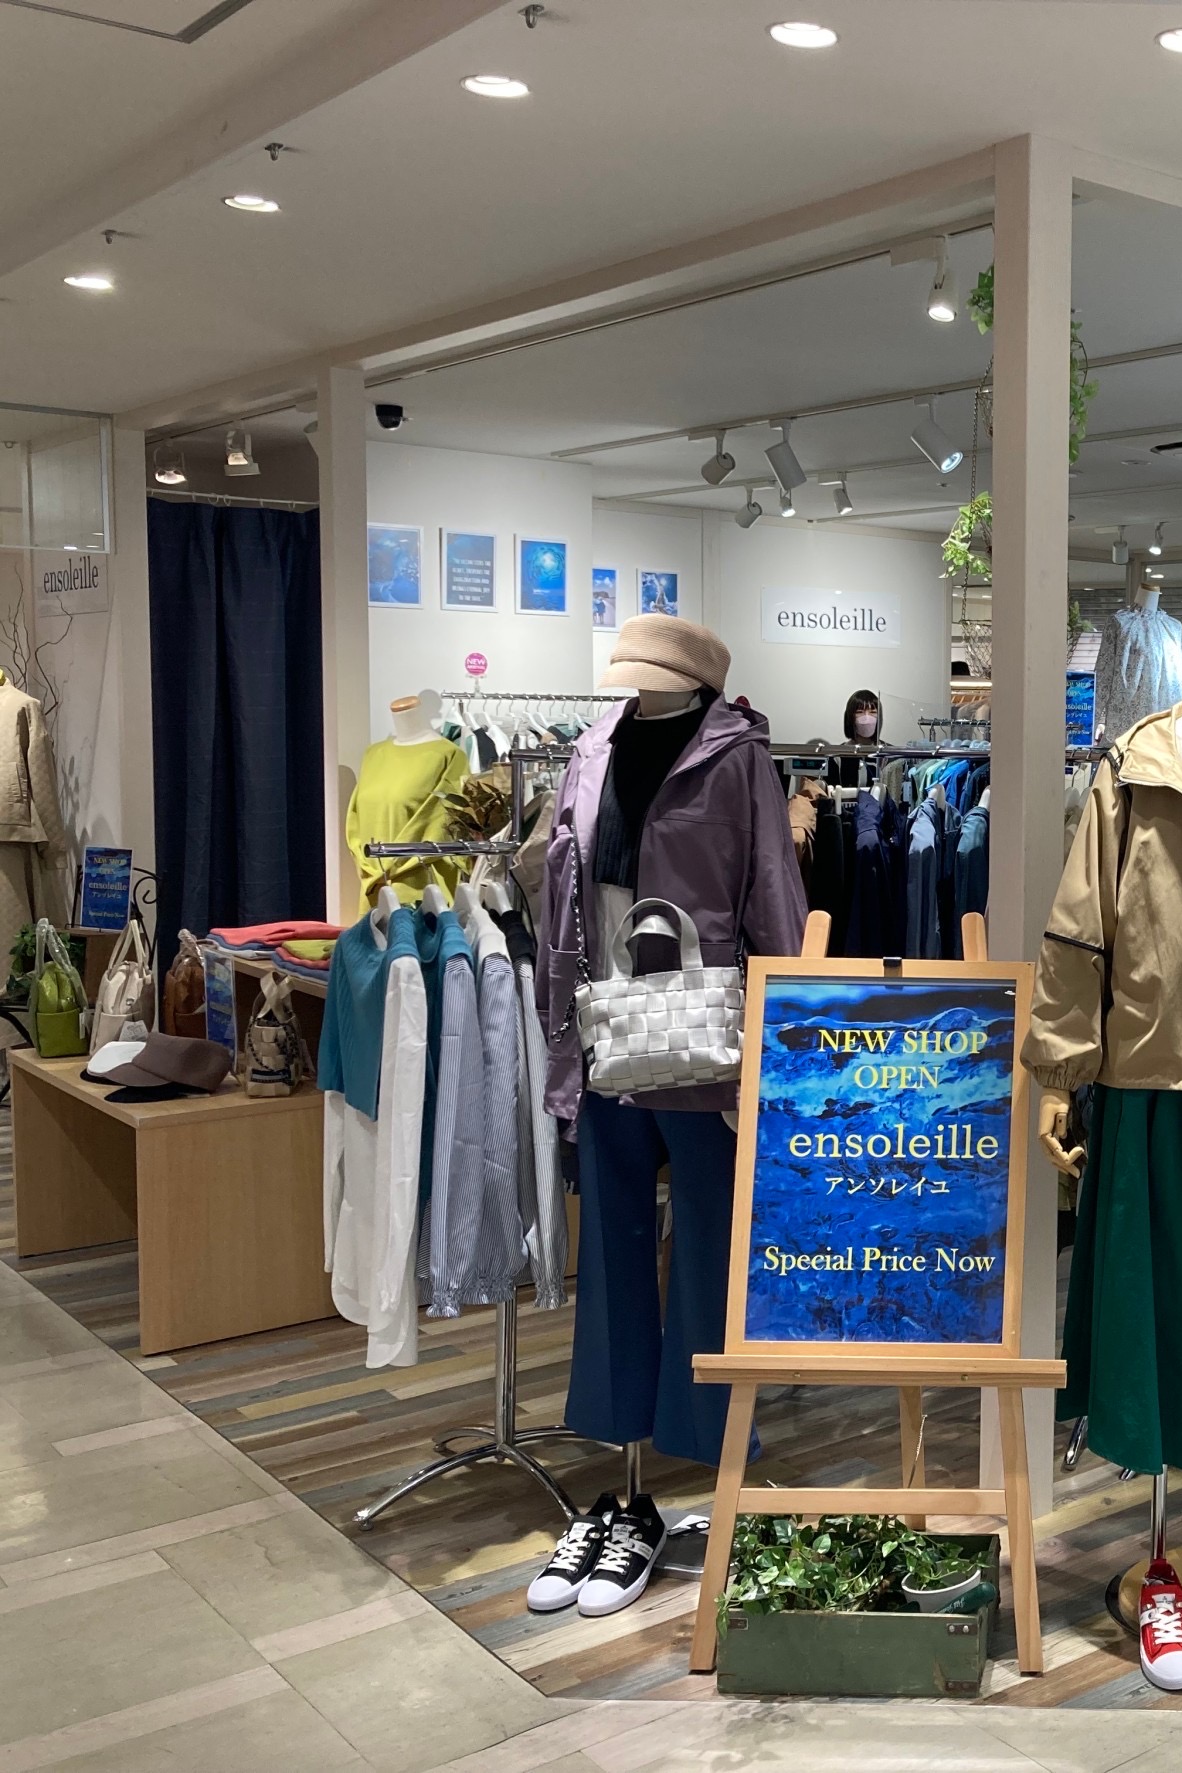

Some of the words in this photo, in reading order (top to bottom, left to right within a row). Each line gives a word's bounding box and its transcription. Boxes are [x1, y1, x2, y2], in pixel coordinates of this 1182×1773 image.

[43, 555, 99, 593] ensoleille
[777, 606, 887, 632] ensoleille
[818, 1029, 896, 1053] NEW
[902, 1030, 988, 1054] SHOP
[854, 1065, 941, 1089] OPEN
[789, 1124, 999, 1159] ensoleille
[824, 1176, 950, 1197] アンソレイユ
[763, 1245, 854, 1276] Special
[861, 1247, 926, 1272] Price
[934, 1247, 996, 1272] Now
